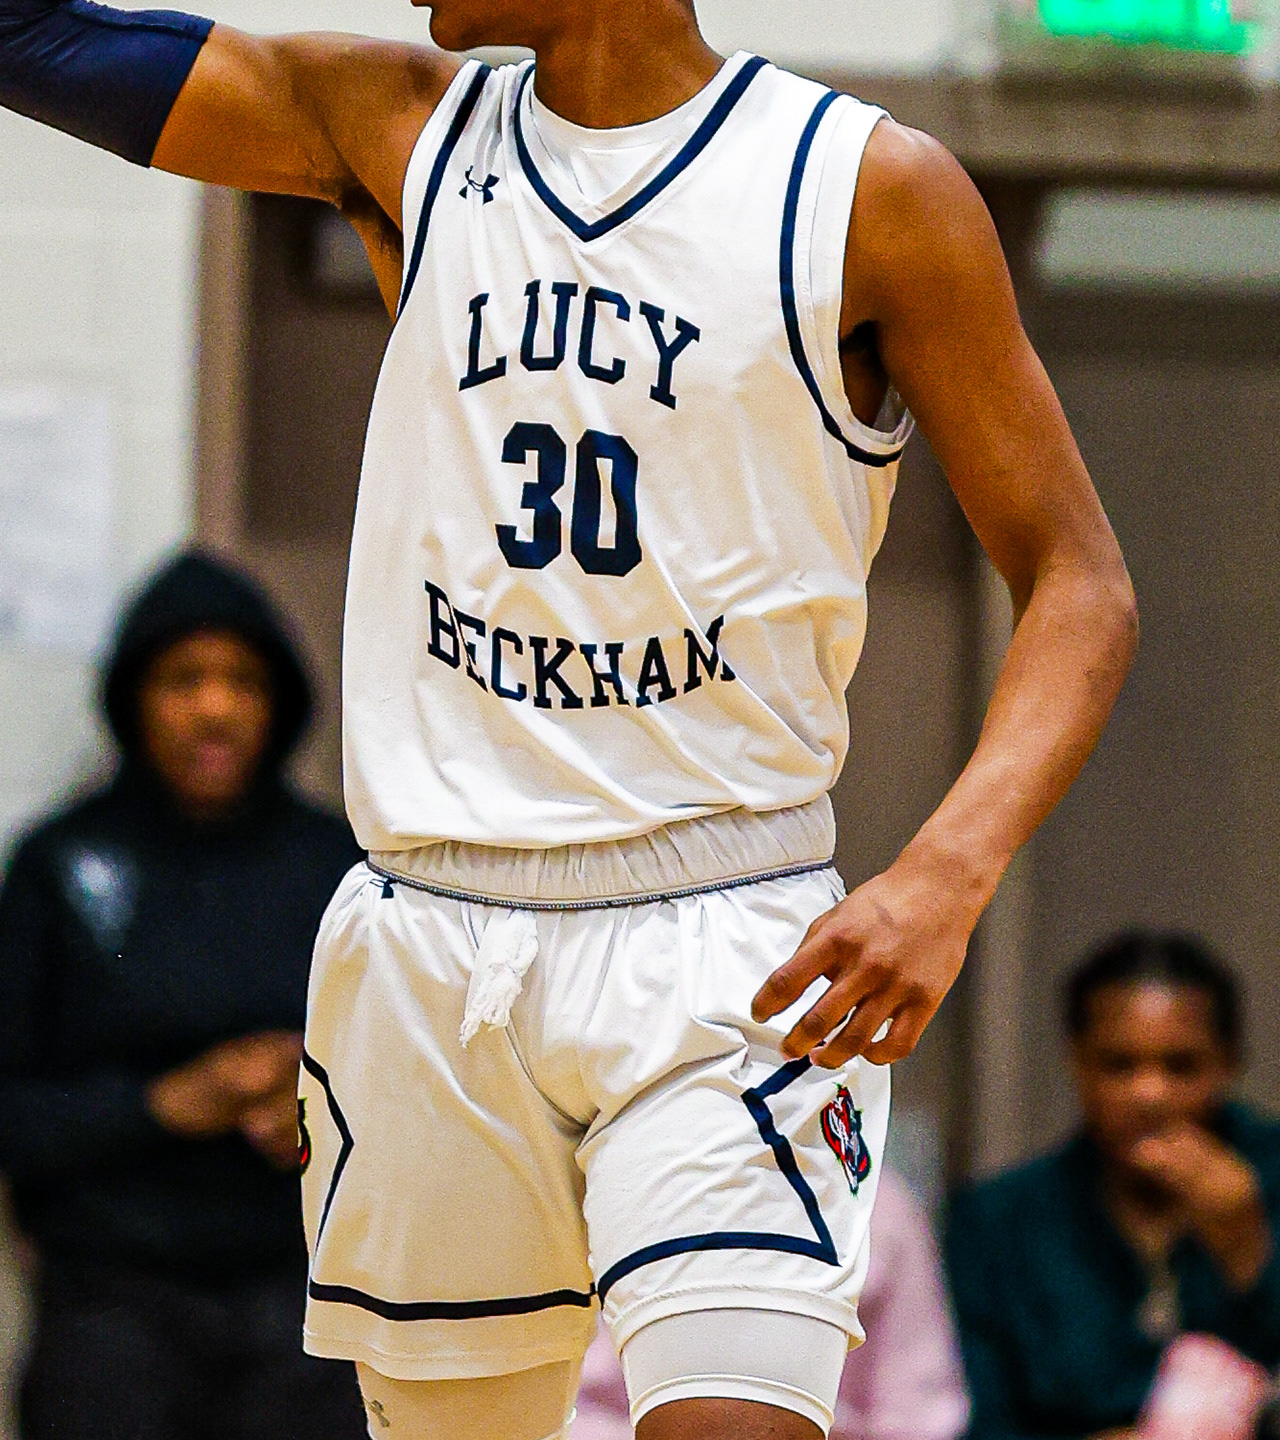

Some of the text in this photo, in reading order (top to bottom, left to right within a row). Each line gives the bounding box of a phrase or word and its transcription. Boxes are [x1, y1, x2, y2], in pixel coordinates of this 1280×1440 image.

[458, 278, 700, 410] LUCY
[496, 423, 642, 576] 30
[423, 580, 736, 710] BECKHAM
